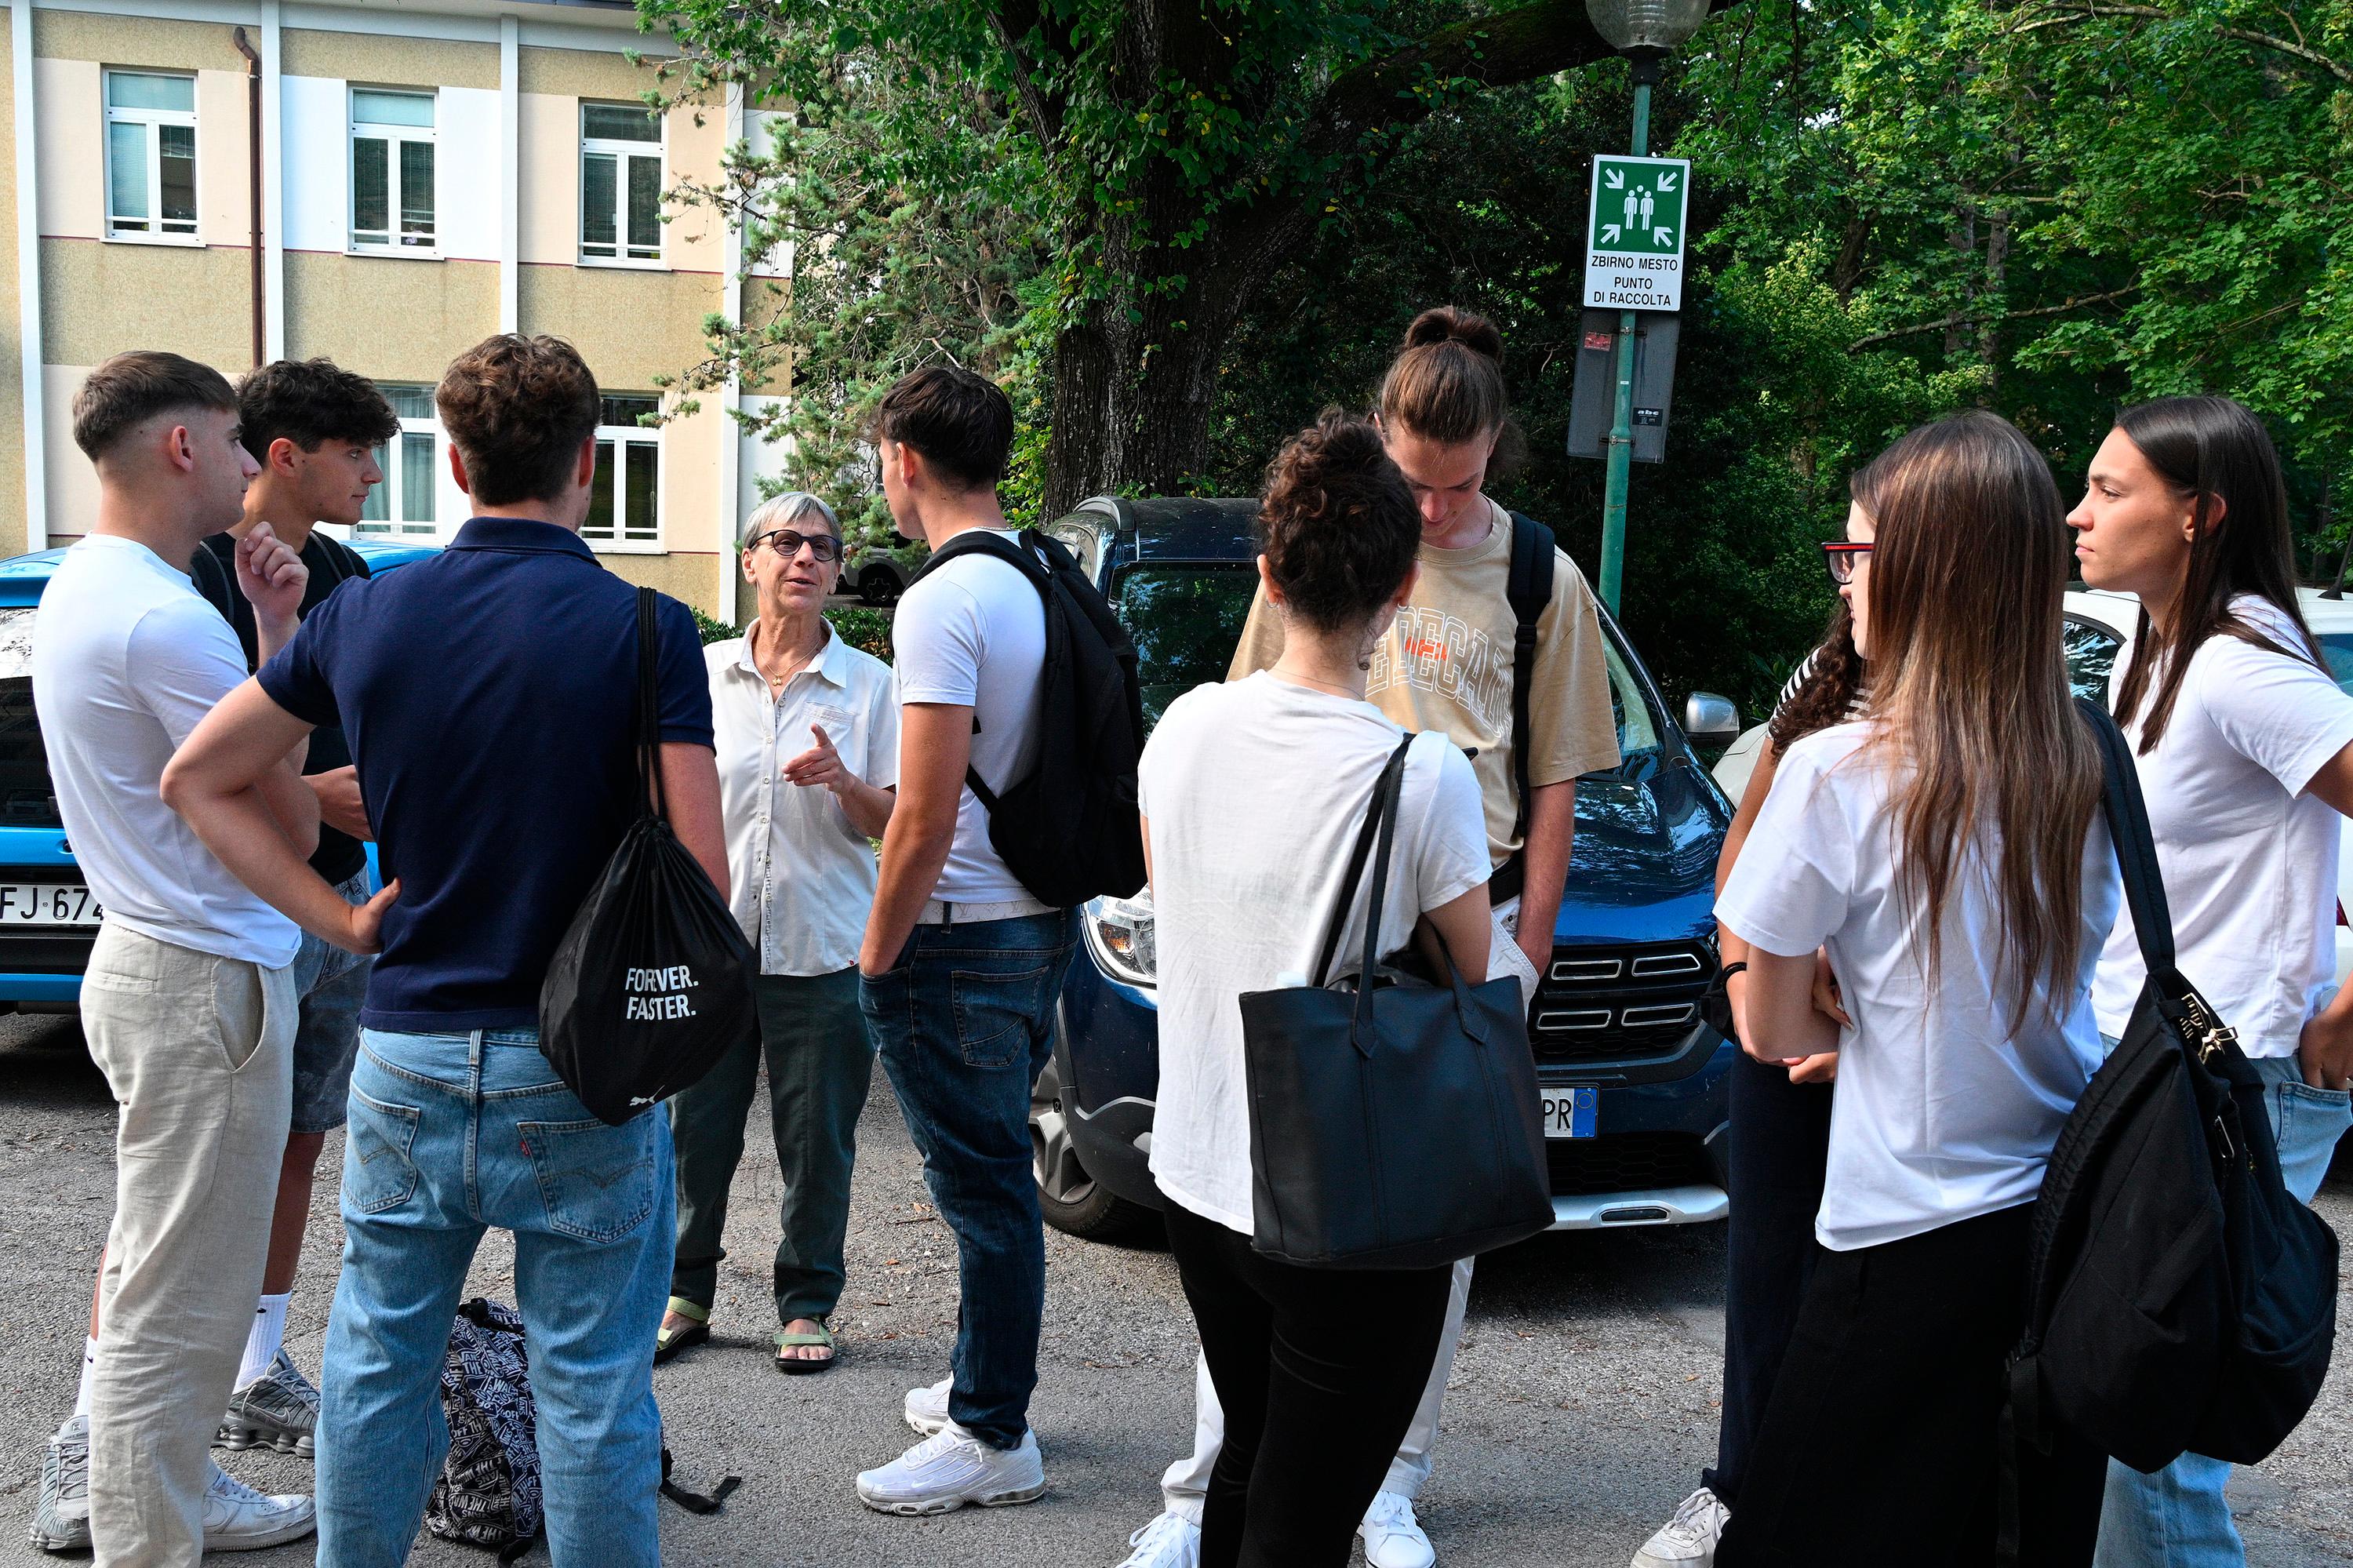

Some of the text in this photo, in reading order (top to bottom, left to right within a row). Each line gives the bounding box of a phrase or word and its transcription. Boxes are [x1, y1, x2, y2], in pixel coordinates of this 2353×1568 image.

[1591, 256, 1678, 271] ZBIRNO MESTO
[1614, 276, 1653, 289] PUNTO
[1594, 291, 1671, 306] DI RACCOLTA
[625, 965, 699, 992] FORVER.
[627, 994, 696, 1020] FASTER.
